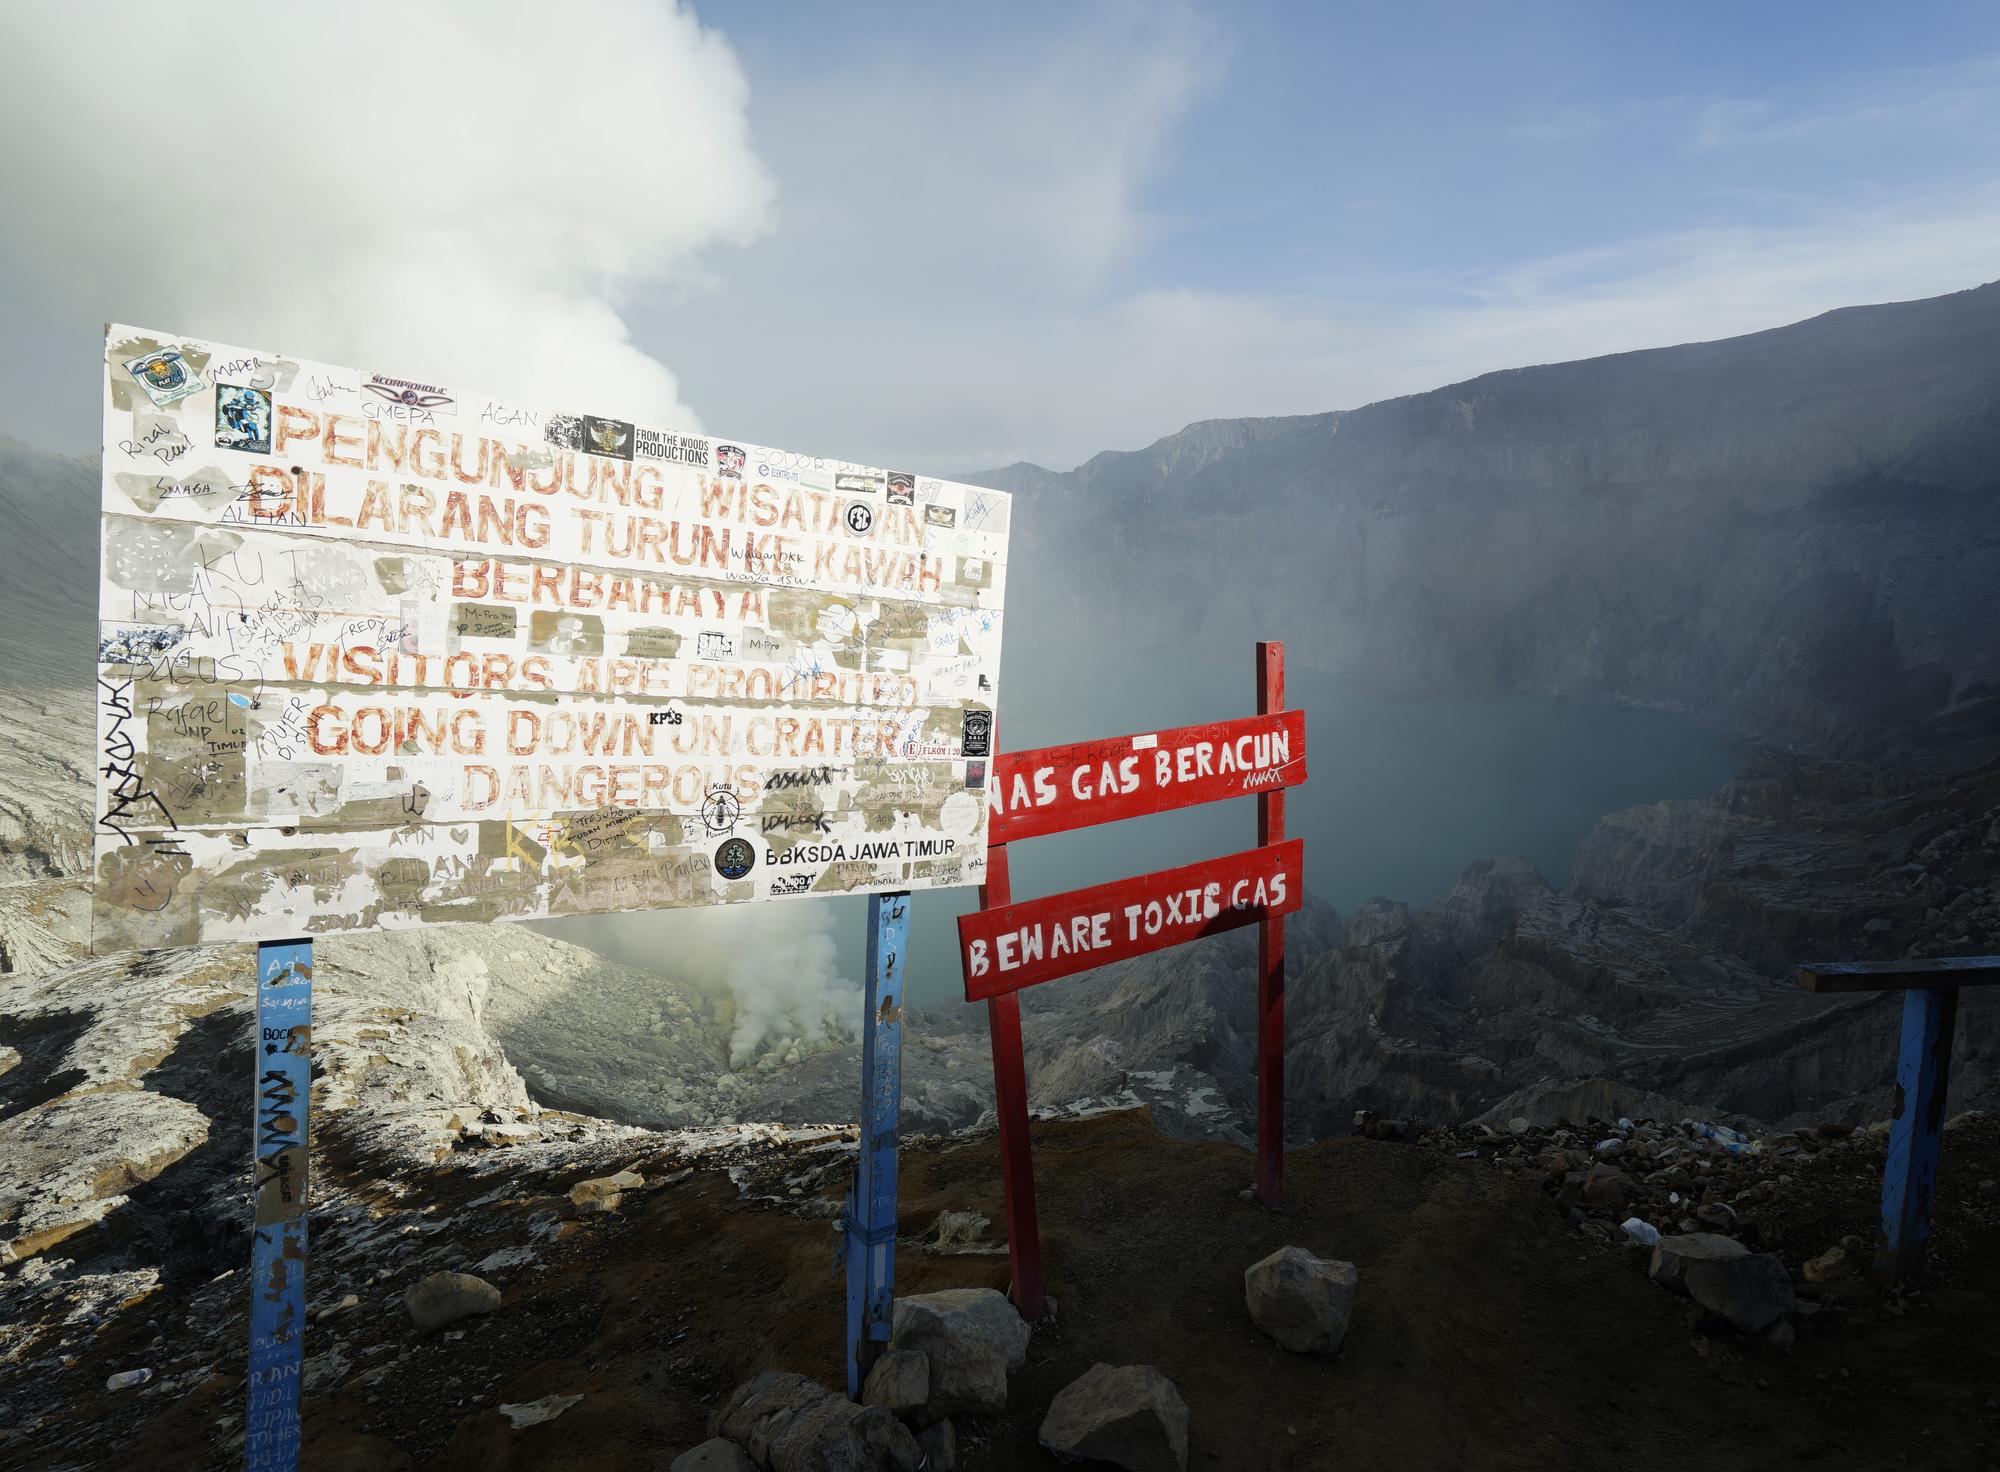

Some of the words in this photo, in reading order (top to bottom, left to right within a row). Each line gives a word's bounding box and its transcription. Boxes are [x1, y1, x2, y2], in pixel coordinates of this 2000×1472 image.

[275, 404, 664, 511] PENGUNJUNG
[635, 441, 709, 465] PRODUCTIONS
[636, 429, 660, 442] FROM
[661, 433, 678, 445] THE
[678, 437, 709, 451] WOODS
[248, 463, 551, 550] DILARANG
[571, 508, 730, 569] TURUN
[746, 531, 800, 577] KE
[813, 539, 943, 593] KAWAH
[452, 560, 764, 622] BERBAHAYA
[281, 641, 554, 699] VISITORS
[573, 658, 671, 704] ARE
[306, 703, 487, 757] GOING
[507, 709, 654, 757] DOWN
[748, 715, 900, 758] CRATER
[461, 763, 760, 811] DANGEROUS
[712, 782, 733, 790] Kutu
[1071, 756, 1140, 800] GAS
[1155, 730, 1290, 788] BERACUN
[765, 845, 845, 868] BBKSDA
[849, 841, 900, 862] JAWA
[900, 839, 955, 860] TIMUR
[968, 911, 1113, 978] BEWARE
[1124, 882, 1221, 942] TOXIC
[1231, 873, 1287, 911] GAS
